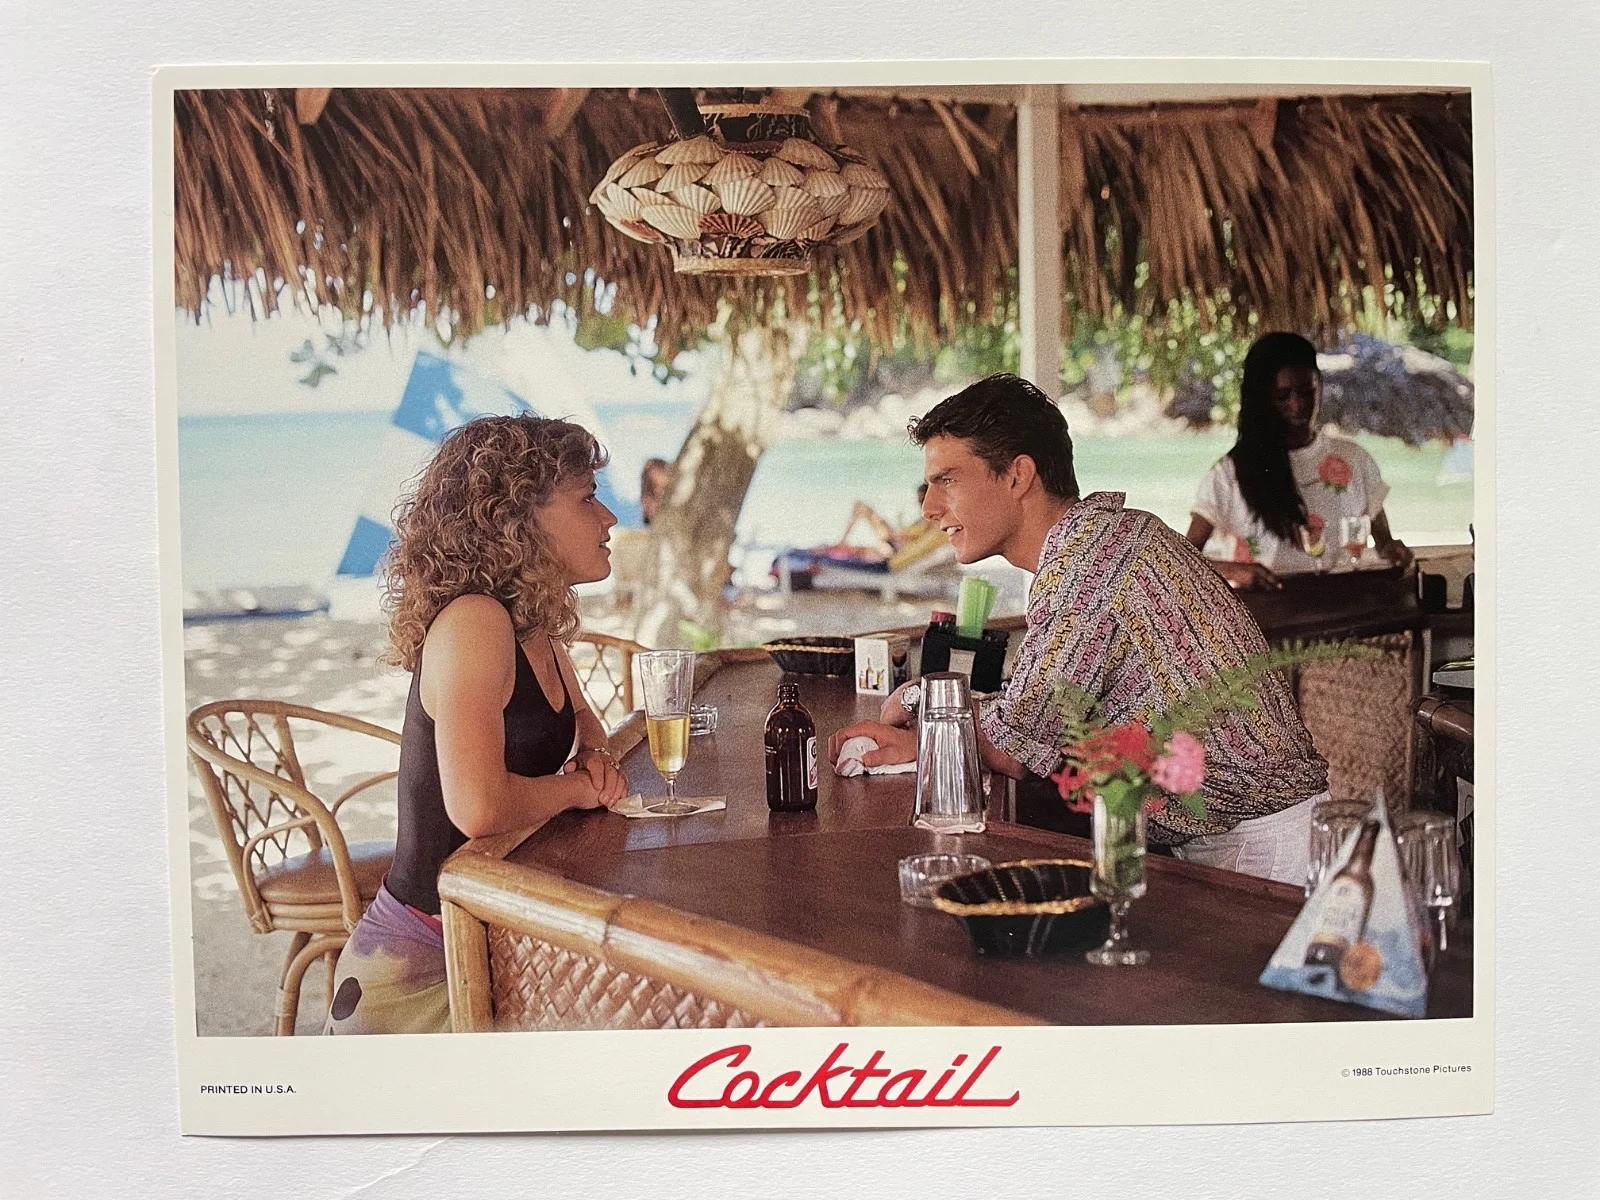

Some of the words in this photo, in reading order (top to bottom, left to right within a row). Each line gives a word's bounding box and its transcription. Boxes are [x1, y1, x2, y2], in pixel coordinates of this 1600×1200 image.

[668, 1042, 1020, 1108] Cocktail
[1375, 1066, 1430, 1076] Touchstone
[1433, 1065, 1472, 1074] Pictures
[200, 1085, 248, 1094] PRINTED
[251, 1085, 263, 1094] IN
[265, 1084, 297, 1094] U.S.A.
